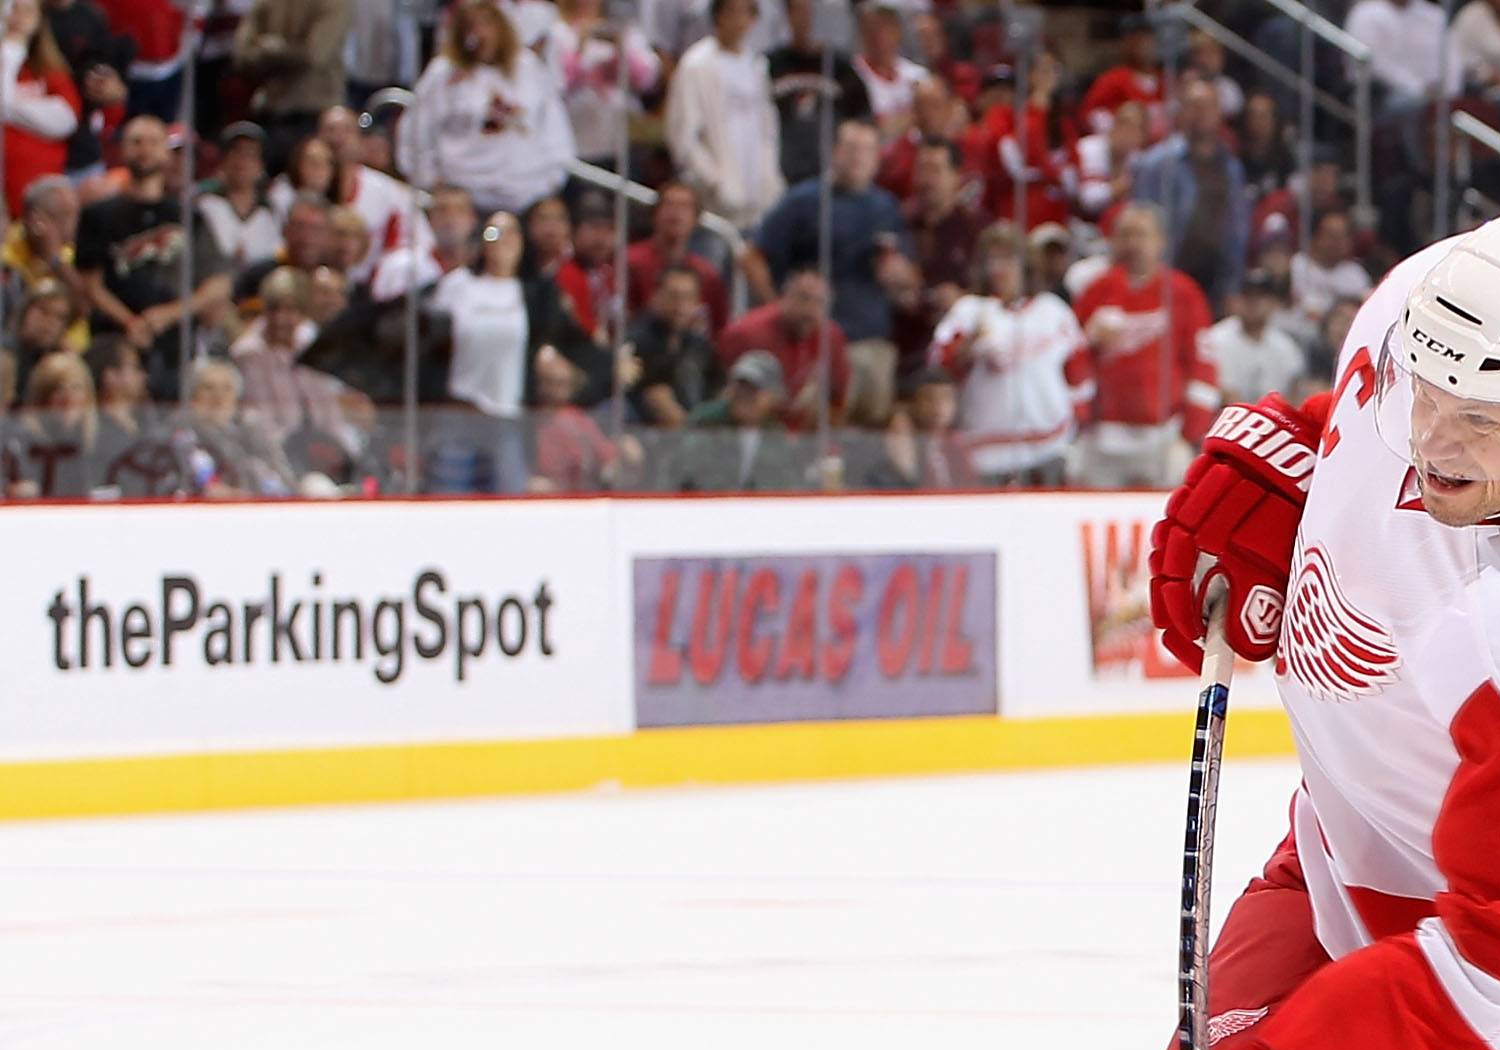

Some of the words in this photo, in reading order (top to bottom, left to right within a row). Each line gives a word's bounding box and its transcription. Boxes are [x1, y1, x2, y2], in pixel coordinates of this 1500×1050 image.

[1411, 328, 1466, 363] CCM
[47, 567, 555, 683] theParkingSpot
[646, 564, 866, 686] LUCAS
[874, 562, 979, 677] OIL
